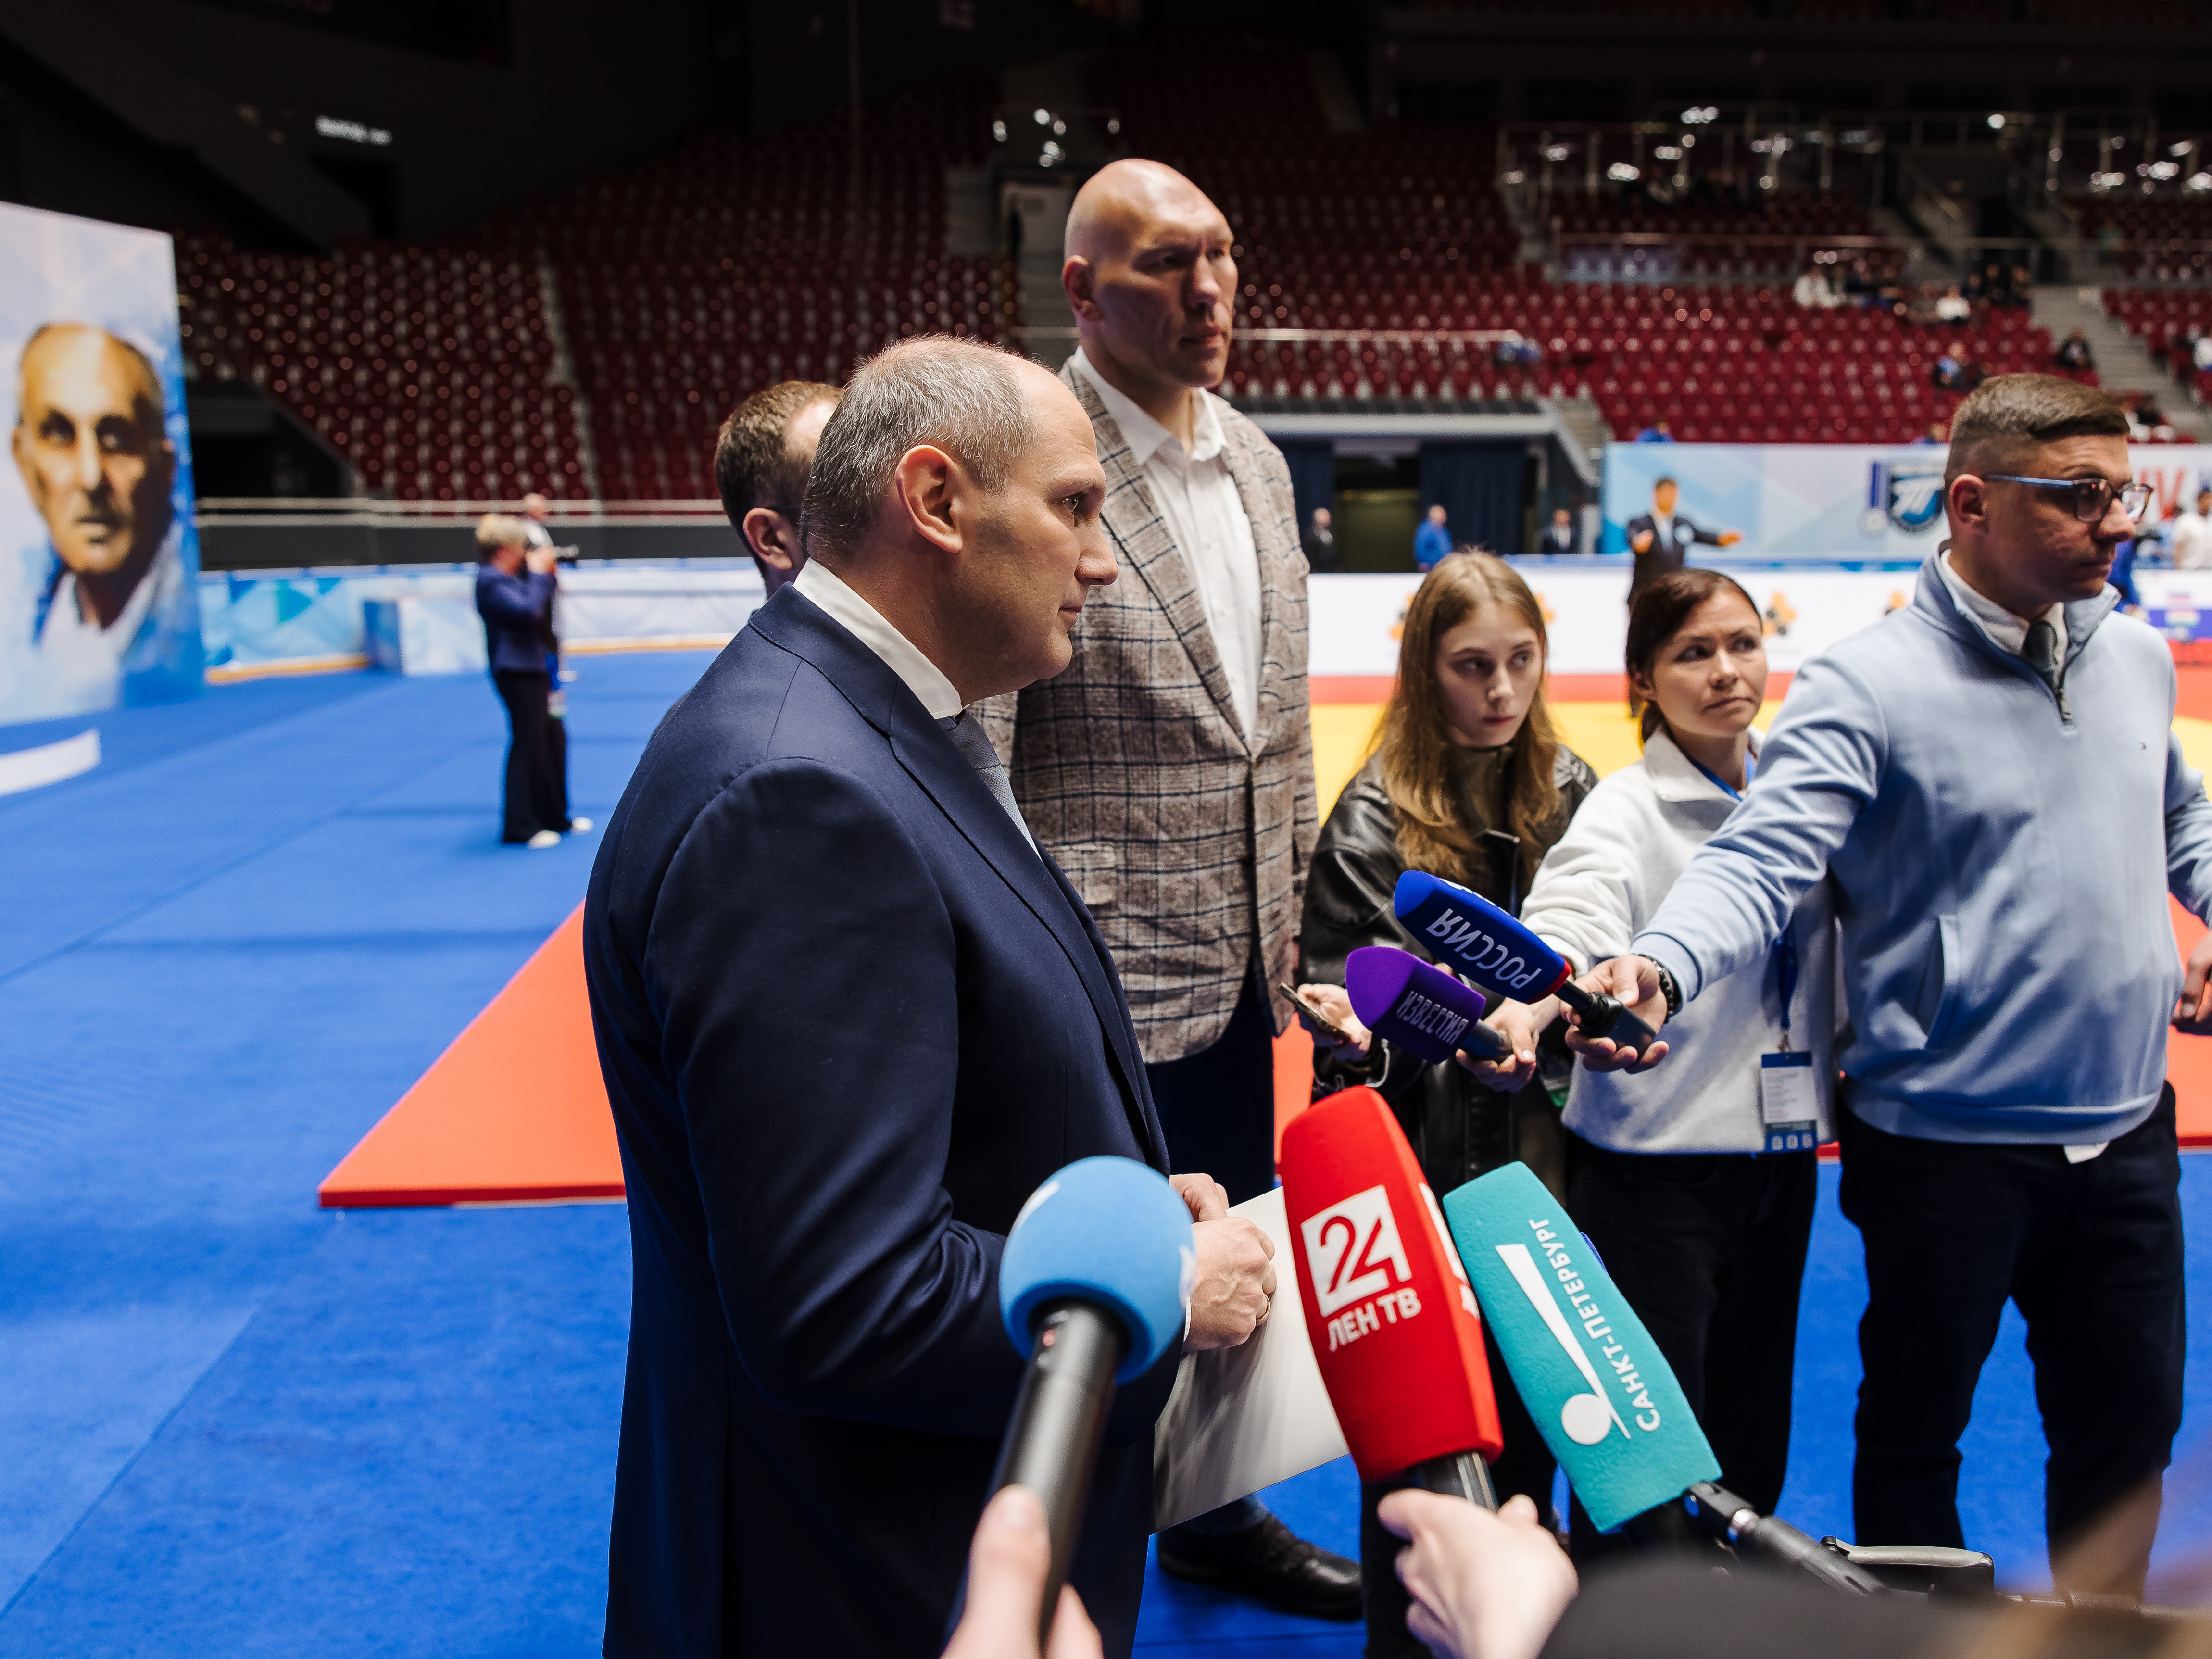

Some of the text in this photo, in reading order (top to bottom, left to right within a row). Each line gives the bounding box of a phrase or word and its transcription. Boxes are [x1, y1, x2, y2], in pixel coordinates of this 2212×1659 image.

[1426, 908, 1542, 989] РОССИЯ
[1396, 991, 1469, 1045] ИЗВЕСТИЯ
[1314, 1206, 1402, 1299] 24
[1528, 1219, 1661, 1432] САНКТ-ПЕТЕРБУРГ
